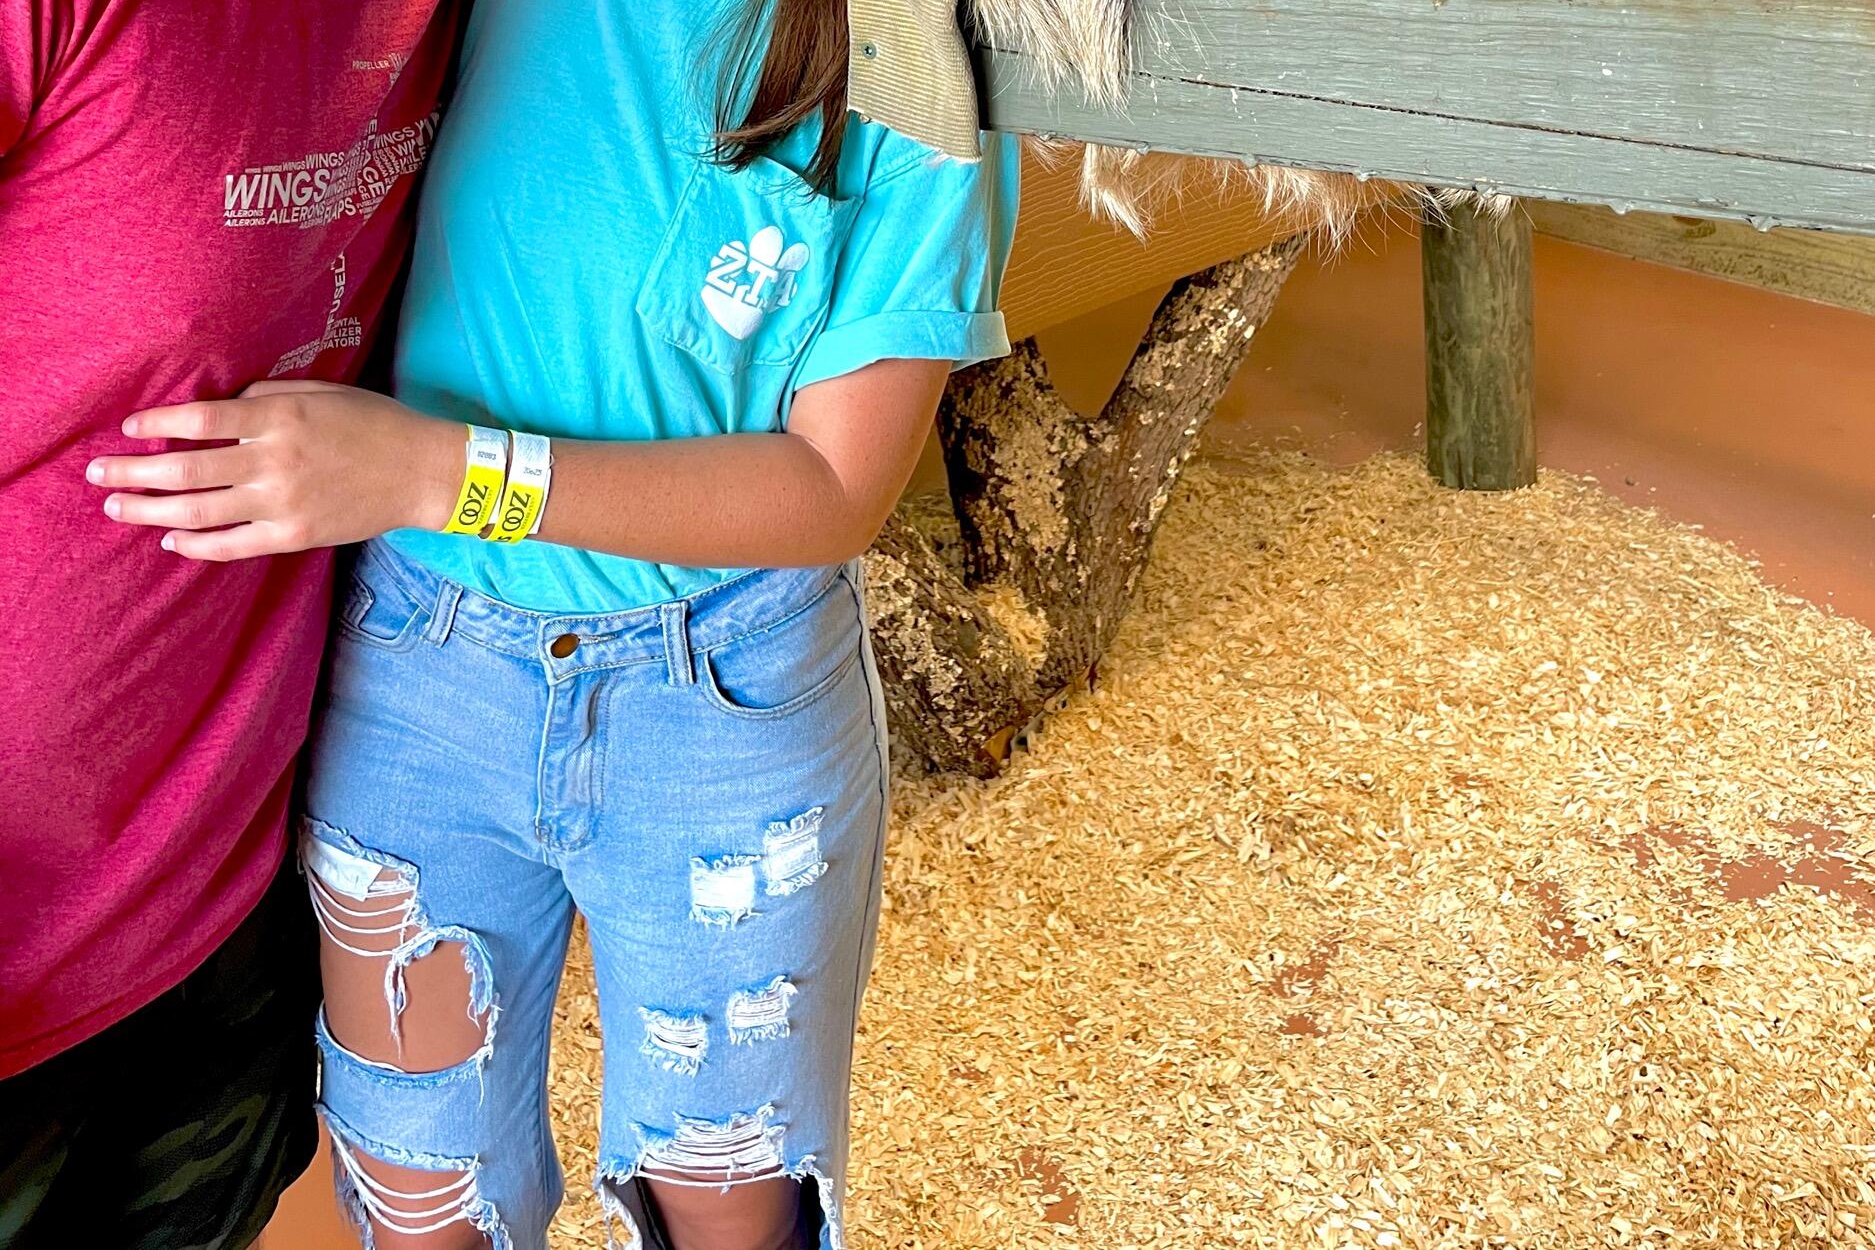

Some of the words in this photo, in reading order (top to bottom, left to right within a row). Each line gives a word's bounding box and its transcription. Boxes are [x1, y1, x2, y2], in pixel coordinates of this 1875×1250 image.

[305, 151, 345, 169] WINGS
[224, 168, 331, 210] WINGS
[223, 210, 264, 218] AILERONS
[224, 217, 266, 227] AILERONS
[266, 201, 326, 225] AILERONS
[458, 481, 490, 526] ZOO
[501, 490, 532, 532] ZOO
